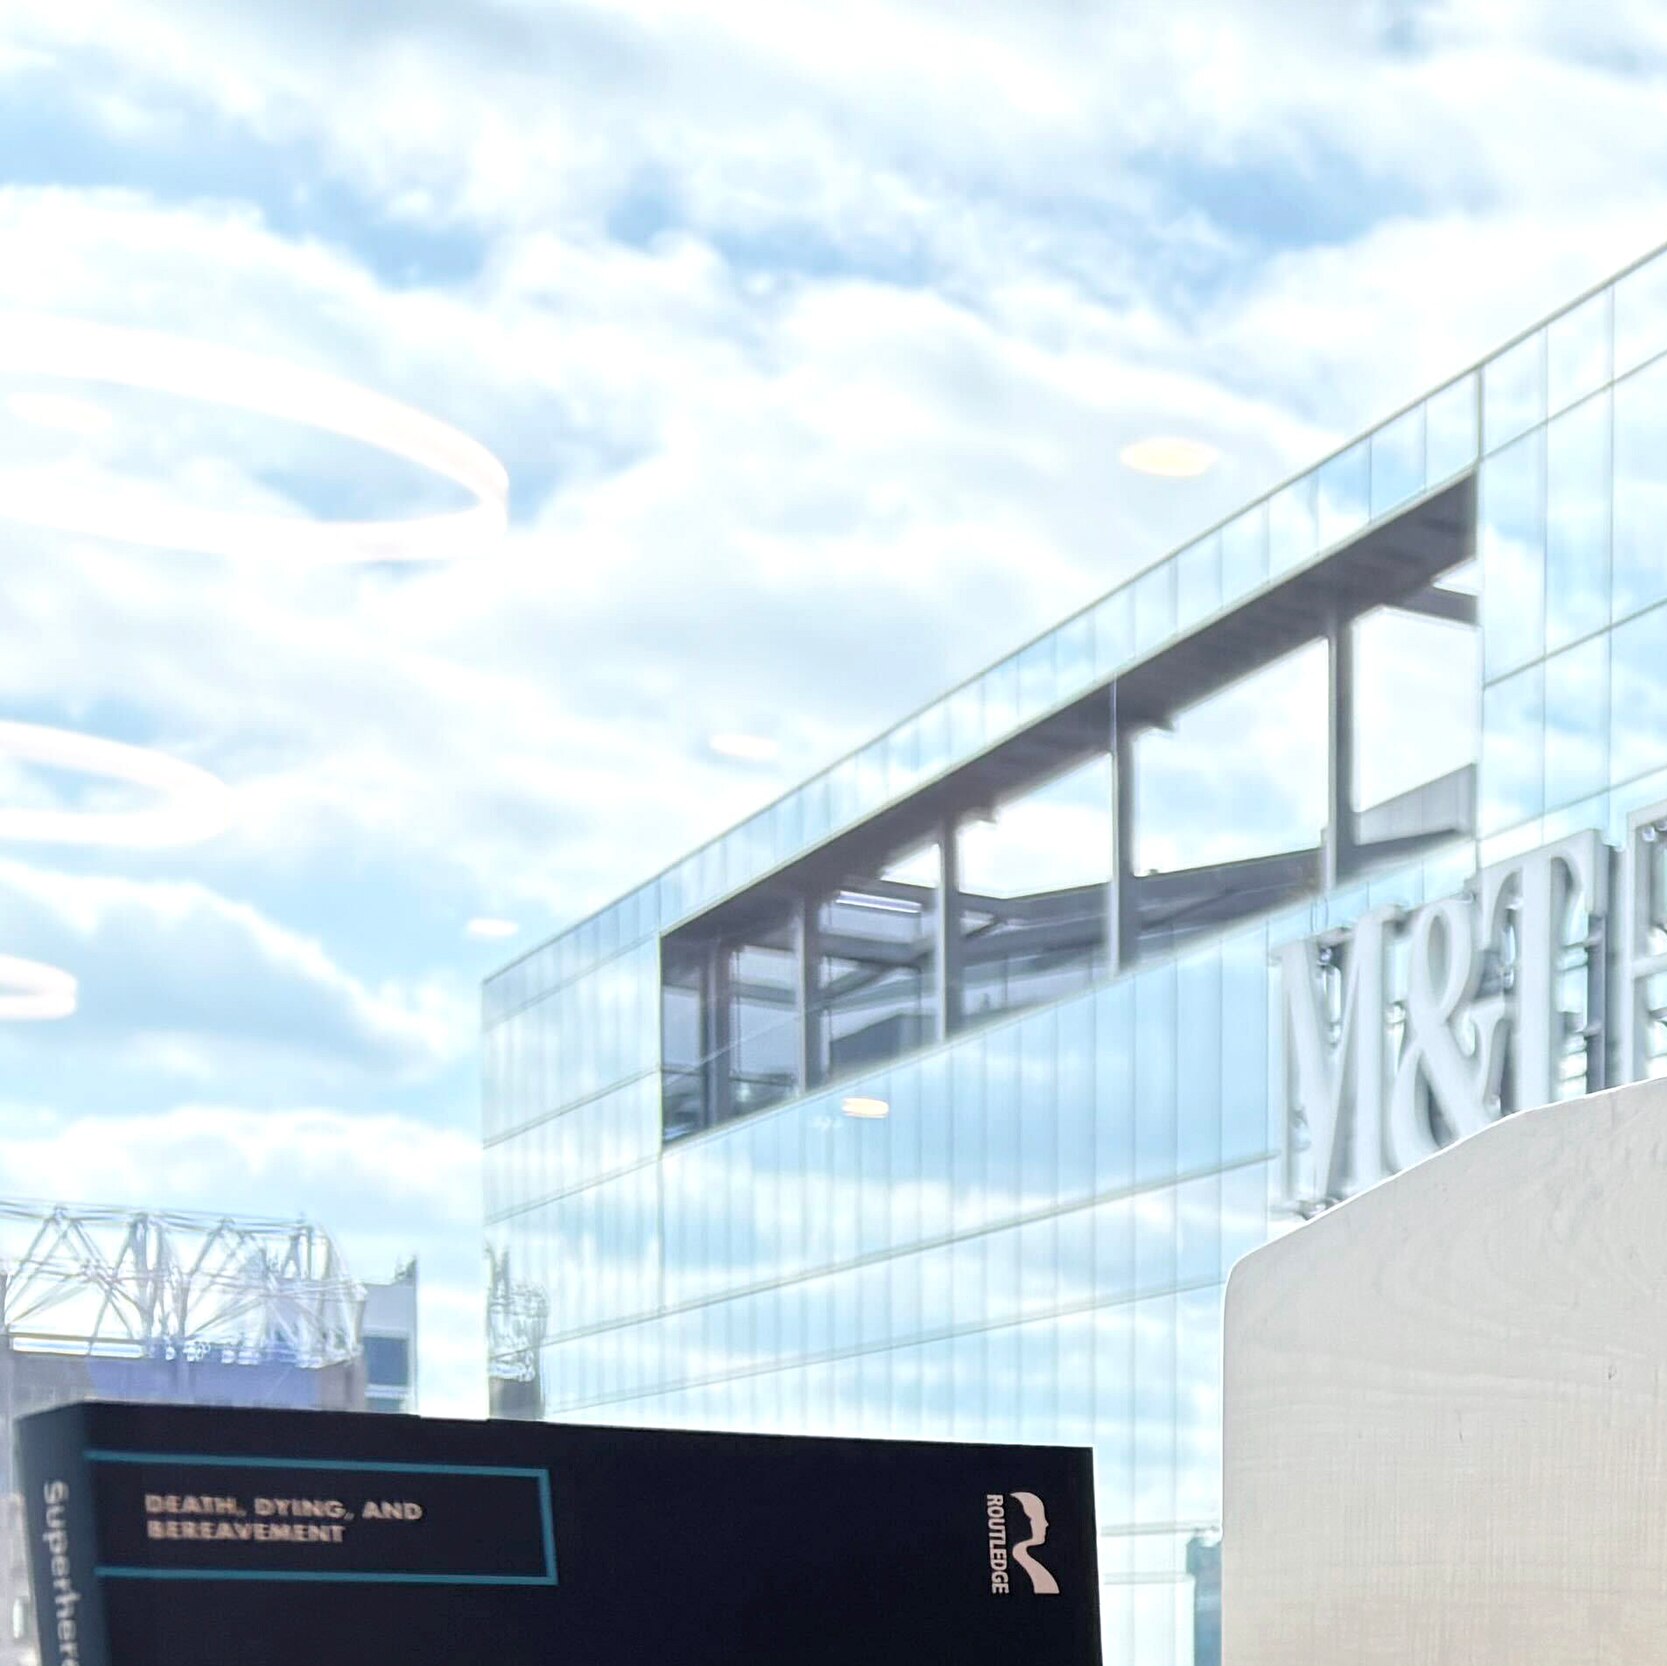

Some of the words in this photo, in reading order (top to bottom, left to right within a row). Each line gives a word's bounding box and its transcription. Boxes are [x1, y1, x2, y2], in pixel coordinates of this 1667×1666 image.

[1270, 828, 1603, 1220] M&T
[145, 1493, 246, 1517] DEATH,
[254, 1497, 354, 1520] DYING,
[362, 1501, 423, 1520] AND
[147, 1520, 346, 1543] BEREAVEMENT
[986, 1493, 1010, 1595] ROUTLEDGE
